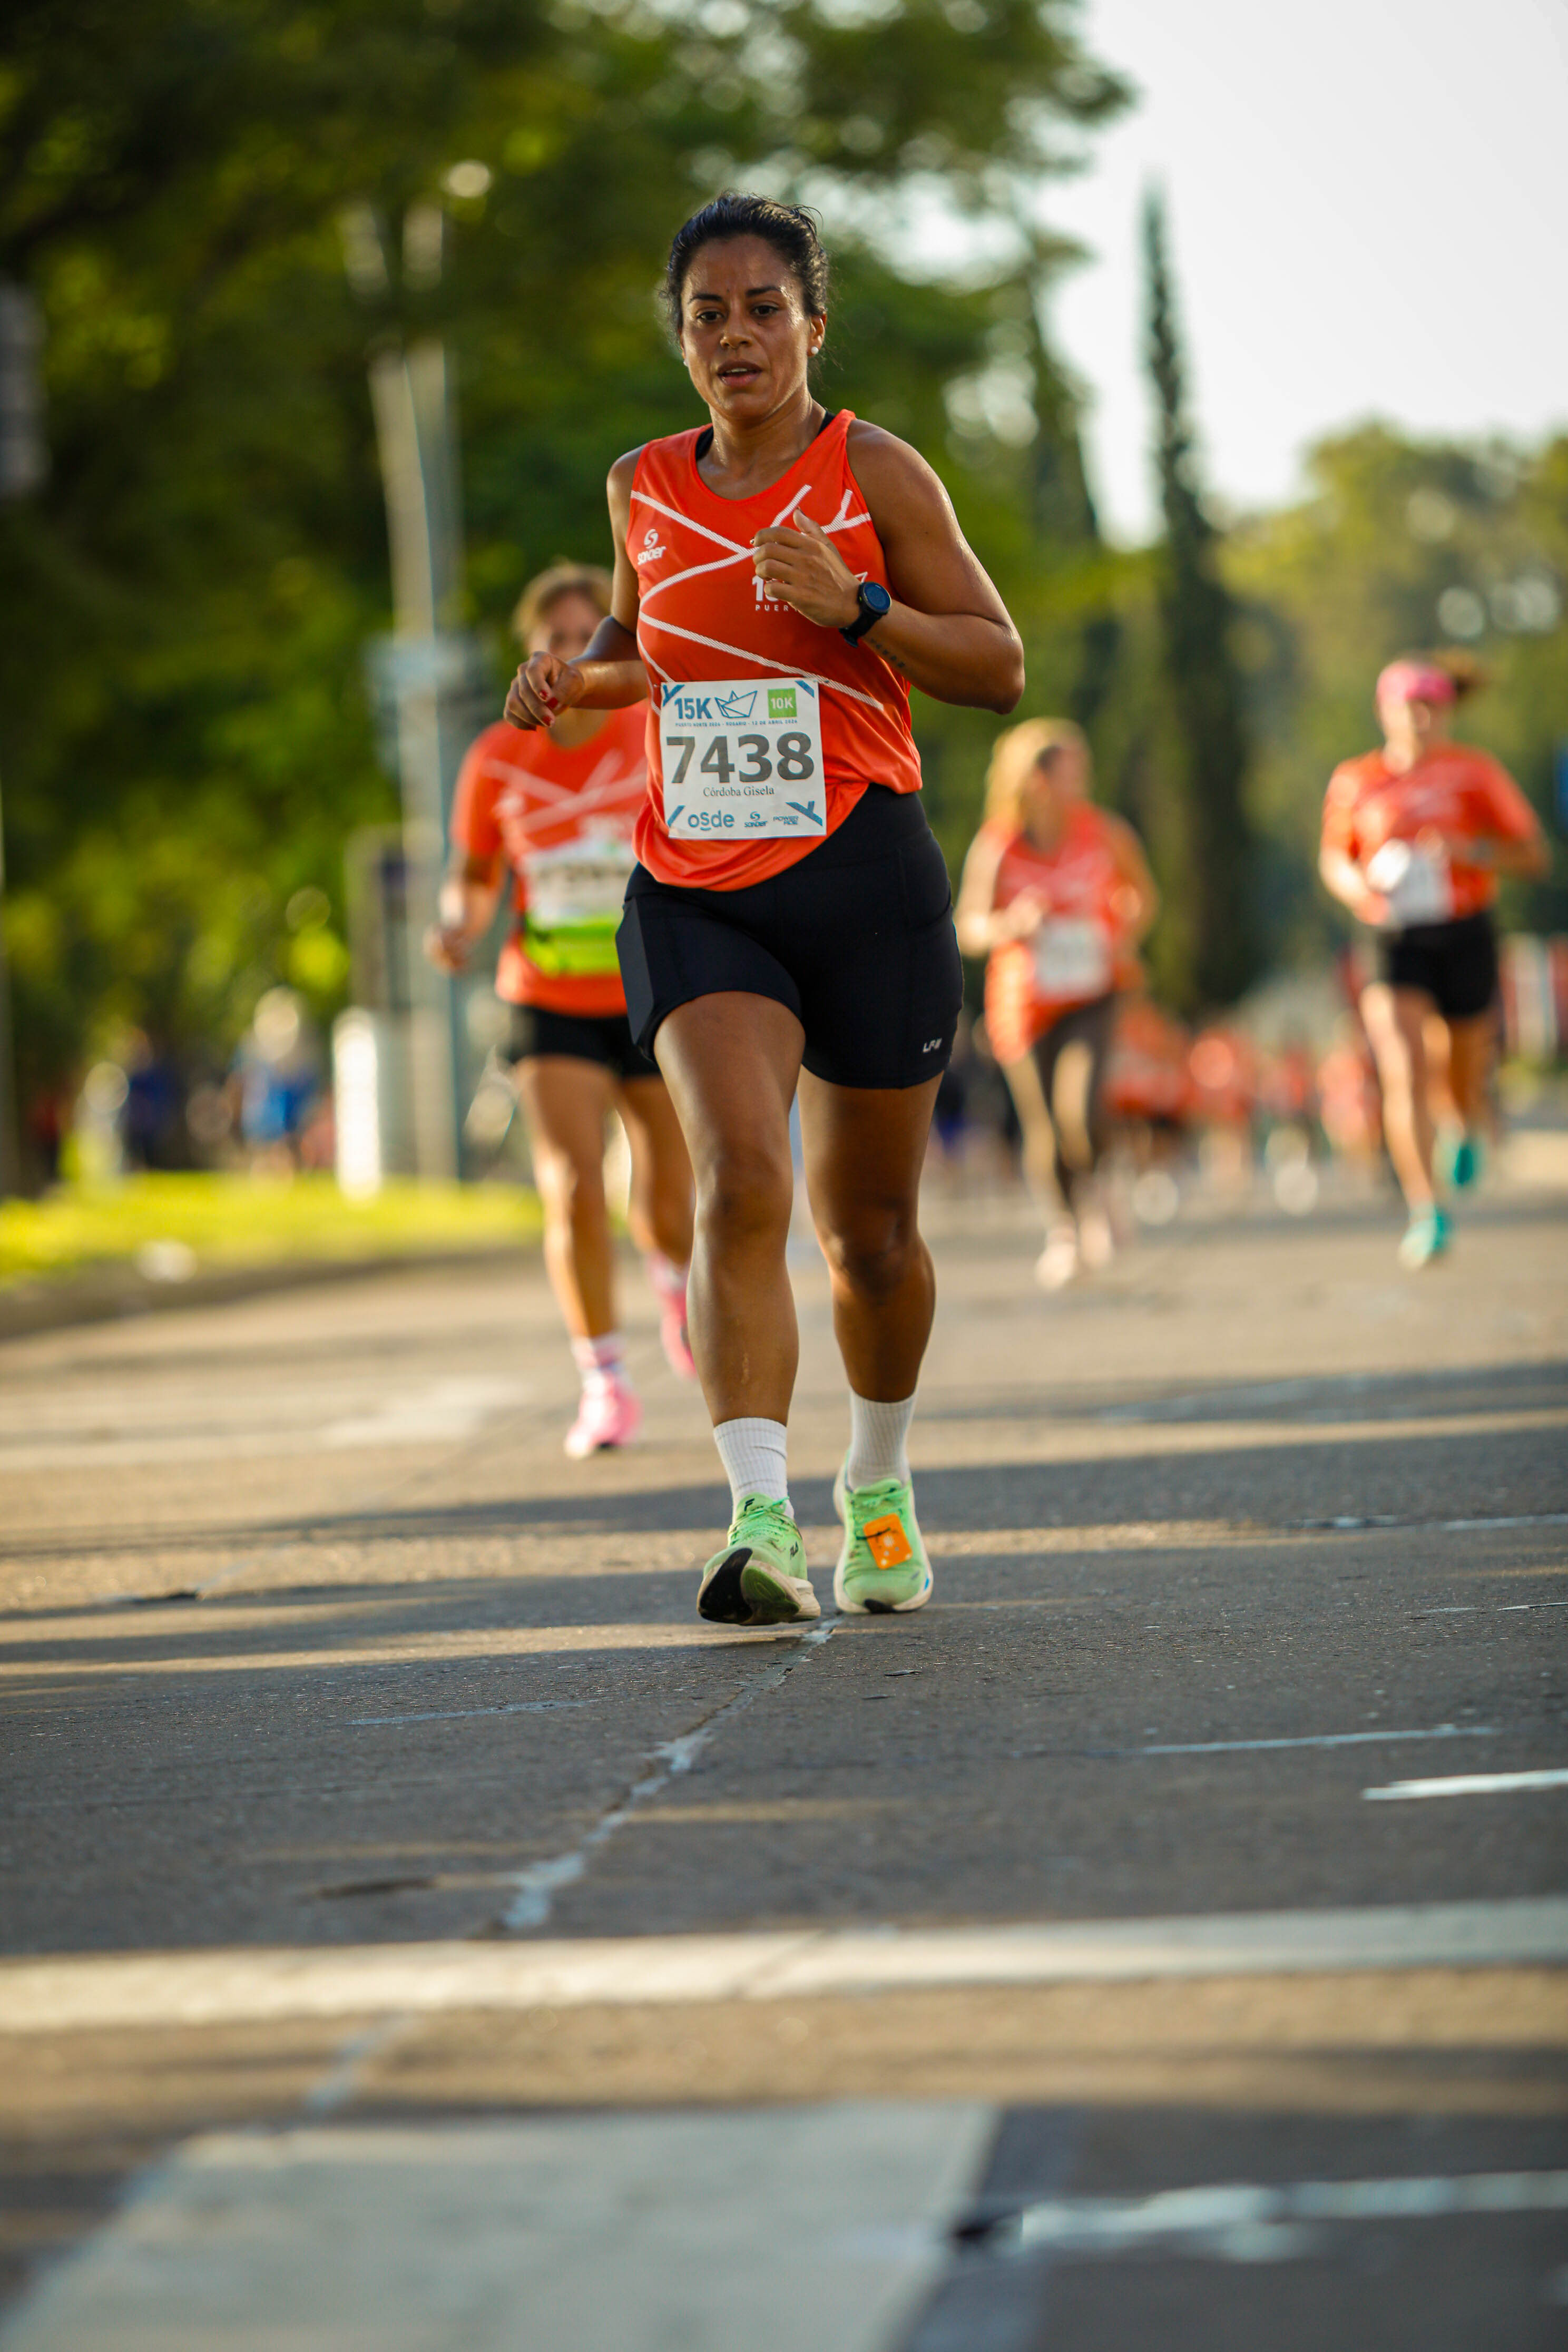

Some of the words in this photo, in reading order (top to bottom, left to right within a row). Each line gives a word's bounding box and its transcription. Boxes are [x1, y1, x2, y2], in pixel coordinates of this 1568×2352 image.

[674, 698, 712, 719] 15K
[771, 697, 793, 709] 10K
[666, 731, 814, 783] 7438
[703, 787, 741, 797] Córdoba
[743, 785, 775, 796] Gisela
[688, 810, 734, 828] osde
